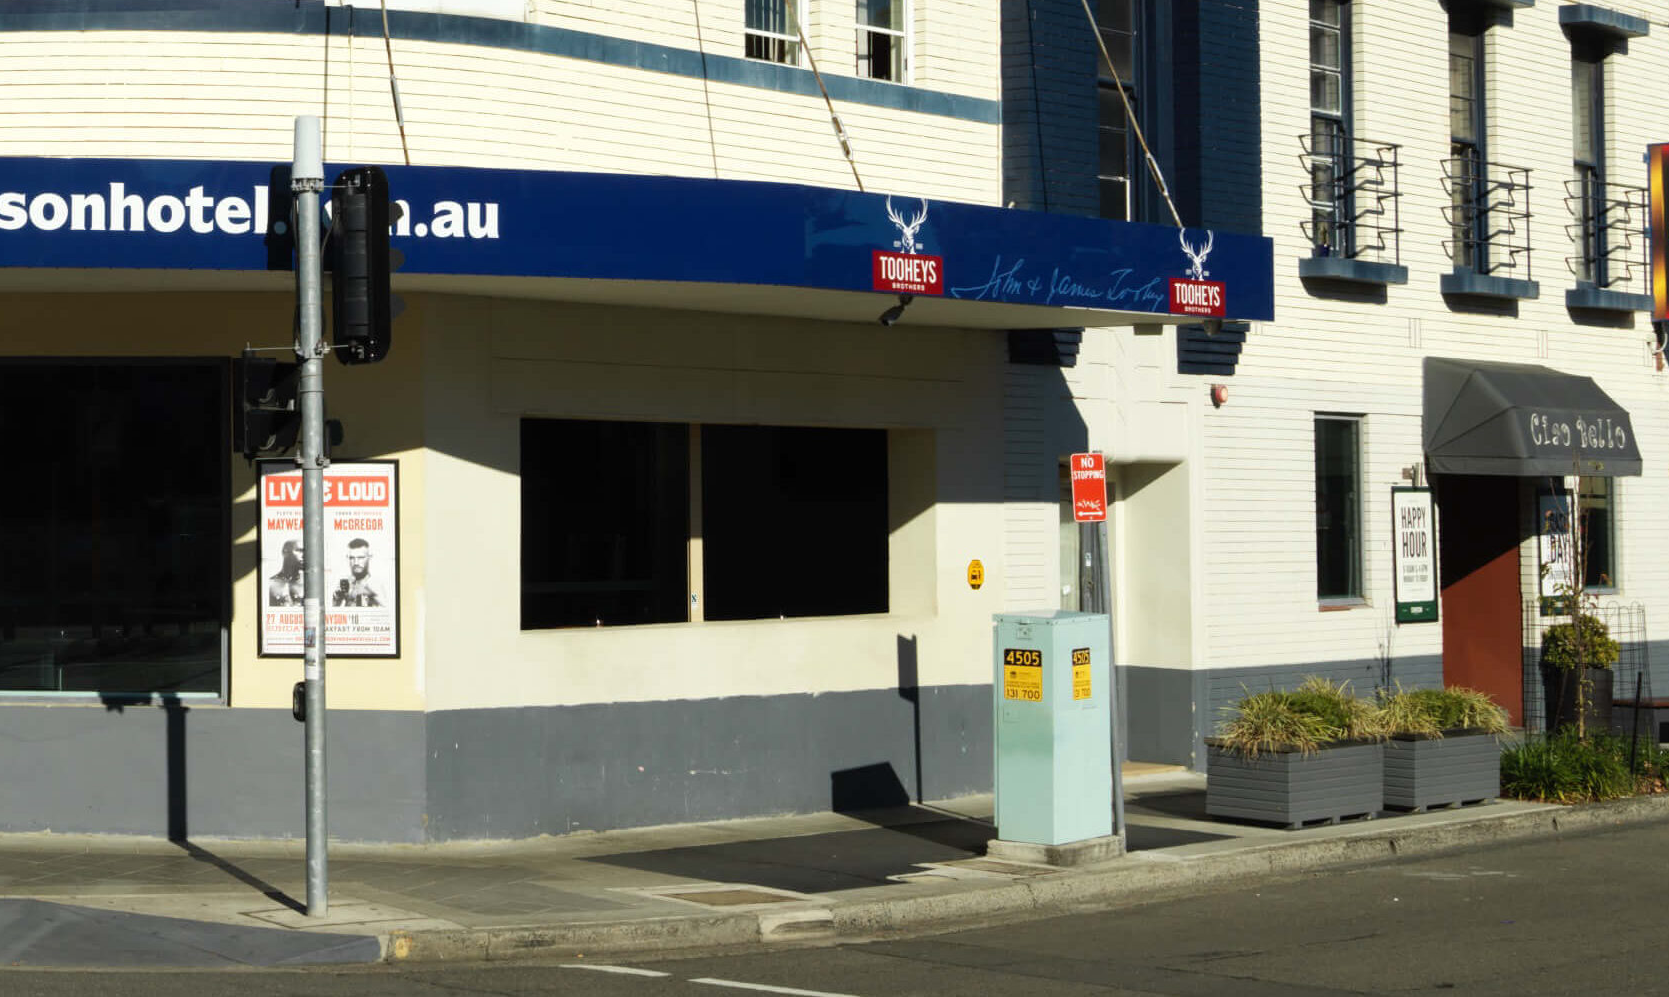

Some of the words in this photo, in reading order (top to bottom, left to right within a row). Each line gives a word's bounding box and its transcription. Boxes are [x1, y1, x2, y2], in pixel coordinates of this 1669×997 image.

[879, 256, 937, 284] TOOHEYS
[951, 255, 1024, 300] John
[892, 282, 925, 291] BROTHERS
[1174, 283, 1221, 307] TOOHEYS
[1184, 305, 1212, 314] BROTHERS
[1531, 413, 1571, 447] Ciao
[1576, 416, 1626, 449] Bello
[1080, 457, 1095, 468] NO
[1073, 470, 1105, 480] STOPPING
[268, 481, 302, 502] LIV
[337, 481, 386, 501] LOUD
[267, 518, 304, 531] MAYWEA
[1401, 506, 1427, 529] HAPPY
[1402, 531, 1428, 558] HOUR
[279, 613, 304, 625] AUGUS
[325, 613, 347, 625] NYSON
[1006, 650, 1040, 665] 4505
[1072, 650, 1089, 665] 4505
[1006, 688, 1018, 698] 131
[1022, 689, 1040, 700] 700
